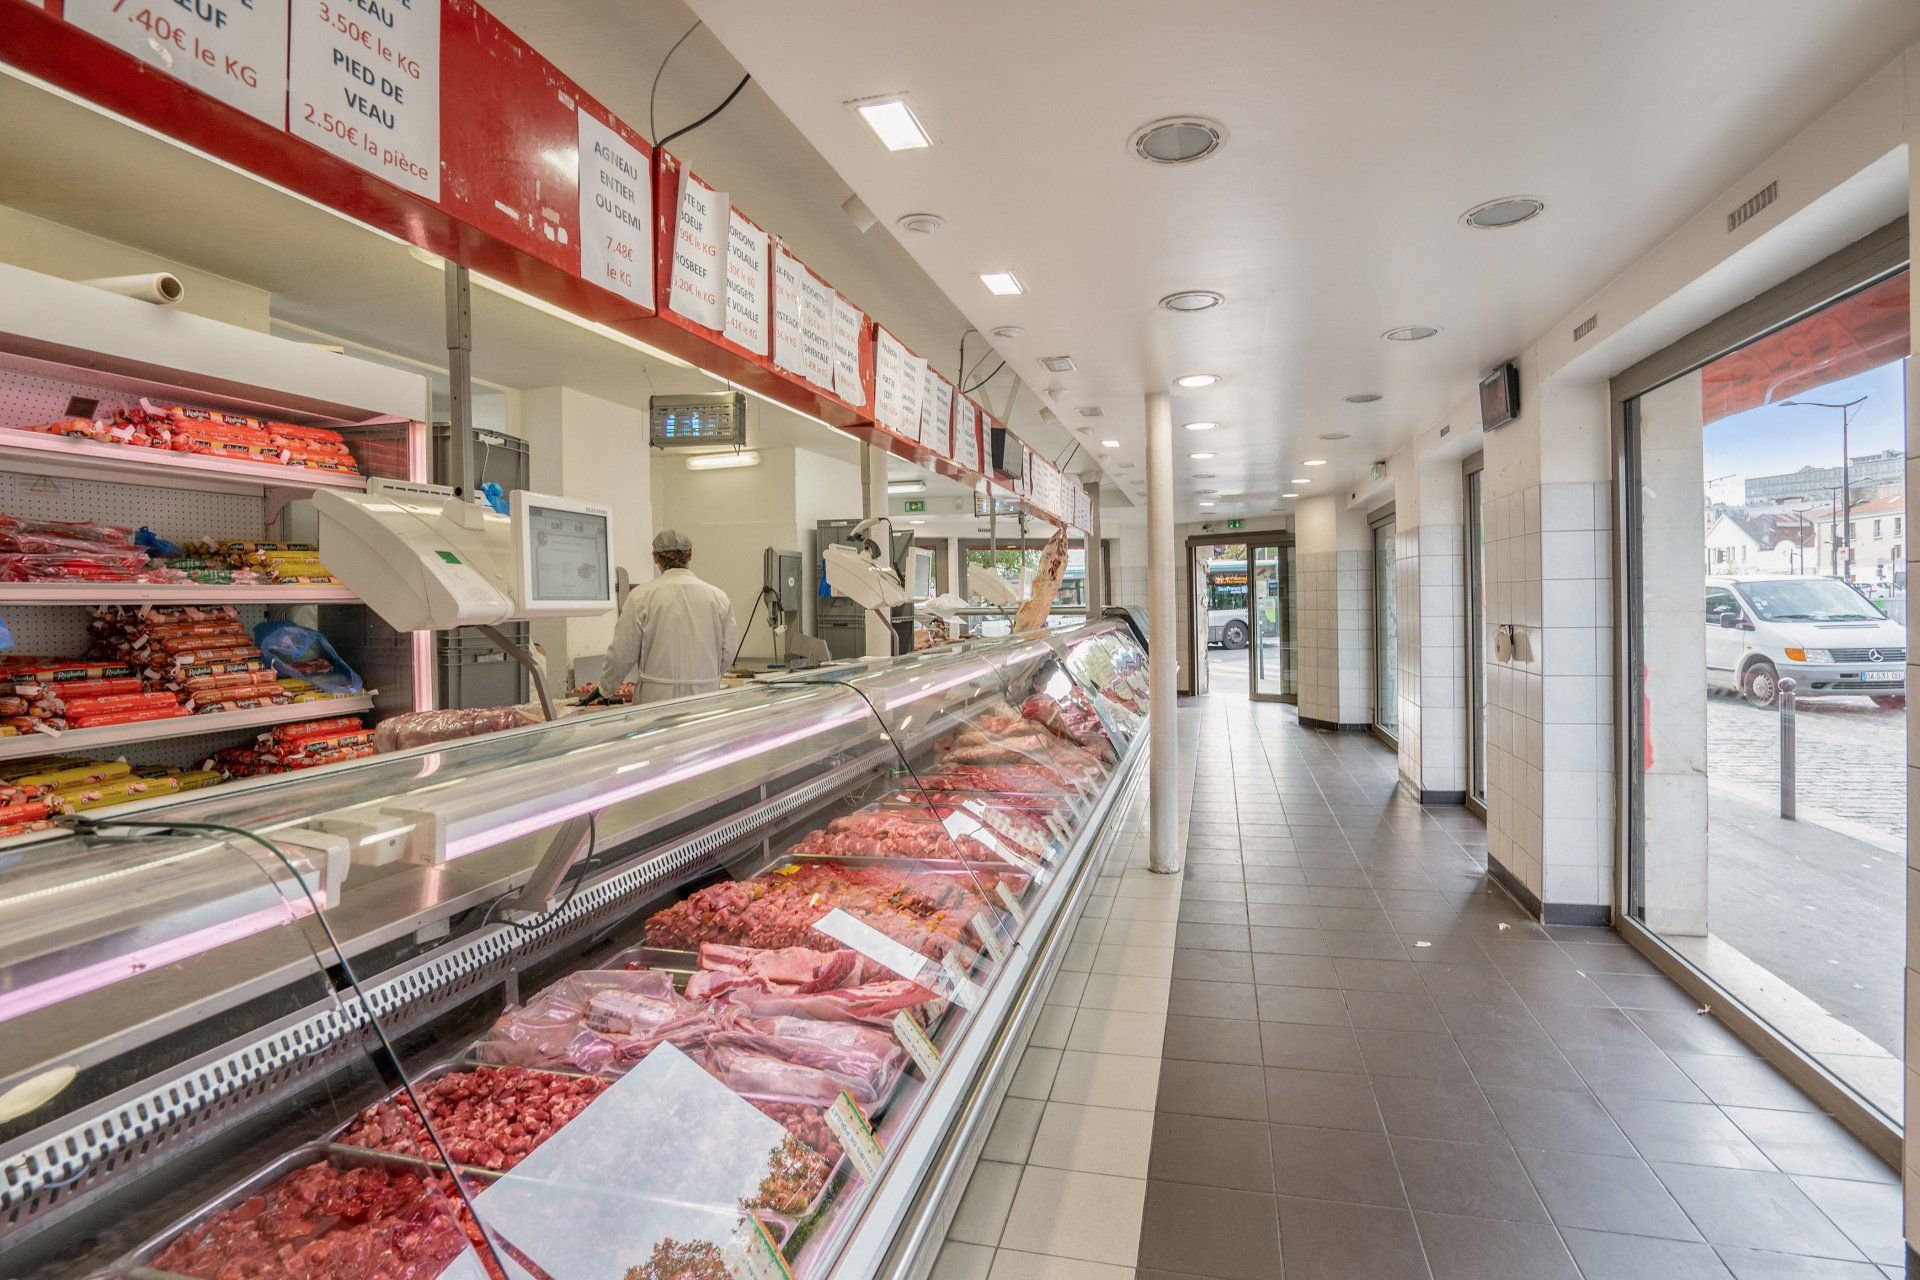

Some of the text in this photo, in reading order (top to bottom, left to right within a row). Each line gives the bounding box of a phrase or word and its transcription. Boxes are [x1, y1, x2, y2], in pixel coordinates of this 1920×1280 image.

[347, 0, 395, 29] EAU
[319, 2, 421, 79] 3.50€ le KG
[195, 37, 216, 67] le
[225, 55, 257, 88] KG
[333, 48, 404, 105] PIED DE
[344, 87, 395, 130] VEAU
[304, 103, 429, 181] 2.50€ la pièce
[594, 141, 638, 181] AGNEAU
[600, 169, 635, 204] ENTIER
[595, 193, 641, 231] OU DEMI
[696, 201, 706, 216] DE
[606, 235, 633, 263] 7.48€
[702, 243, 716, 257] KG
[729, 225, 756, 252] ORDONS
[732, 245, 759, 272] VOLAILLE
[606, 262, 632, 288] le KG
[703, 292, 715, 305] KG
[726, 277, 755, 304] NUGGETS
[732, 300, 760, 324] VOLAILLE
[830, 1108, 850, 1137] POULET
[849, 1137, 857, 1148] DE
